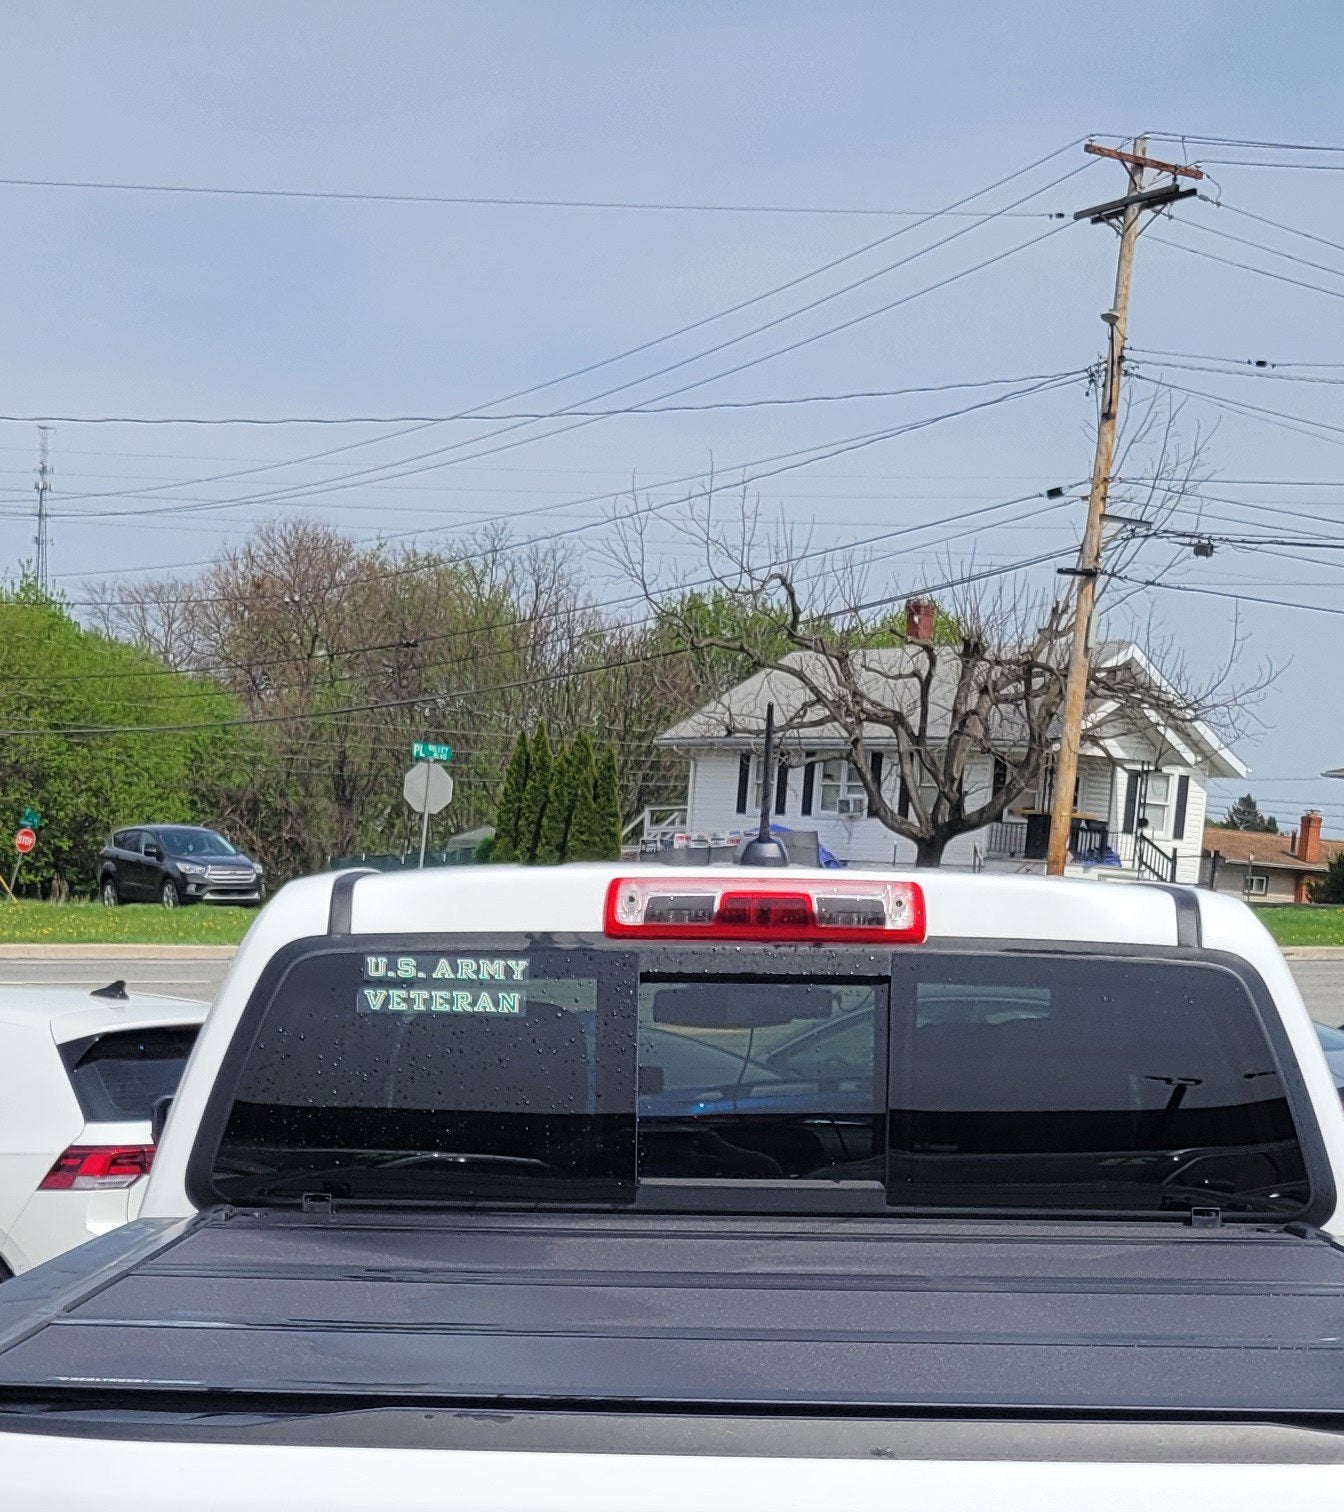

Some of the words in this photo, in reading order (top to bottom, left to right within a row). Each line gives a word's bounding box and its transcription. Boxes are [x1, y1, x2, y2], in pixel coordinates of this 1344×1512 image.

[367, 957, 427, 979] U.S.
[432, 958, 529, 981] ARMY
[363, 989, 520, 1014] VETERAN
